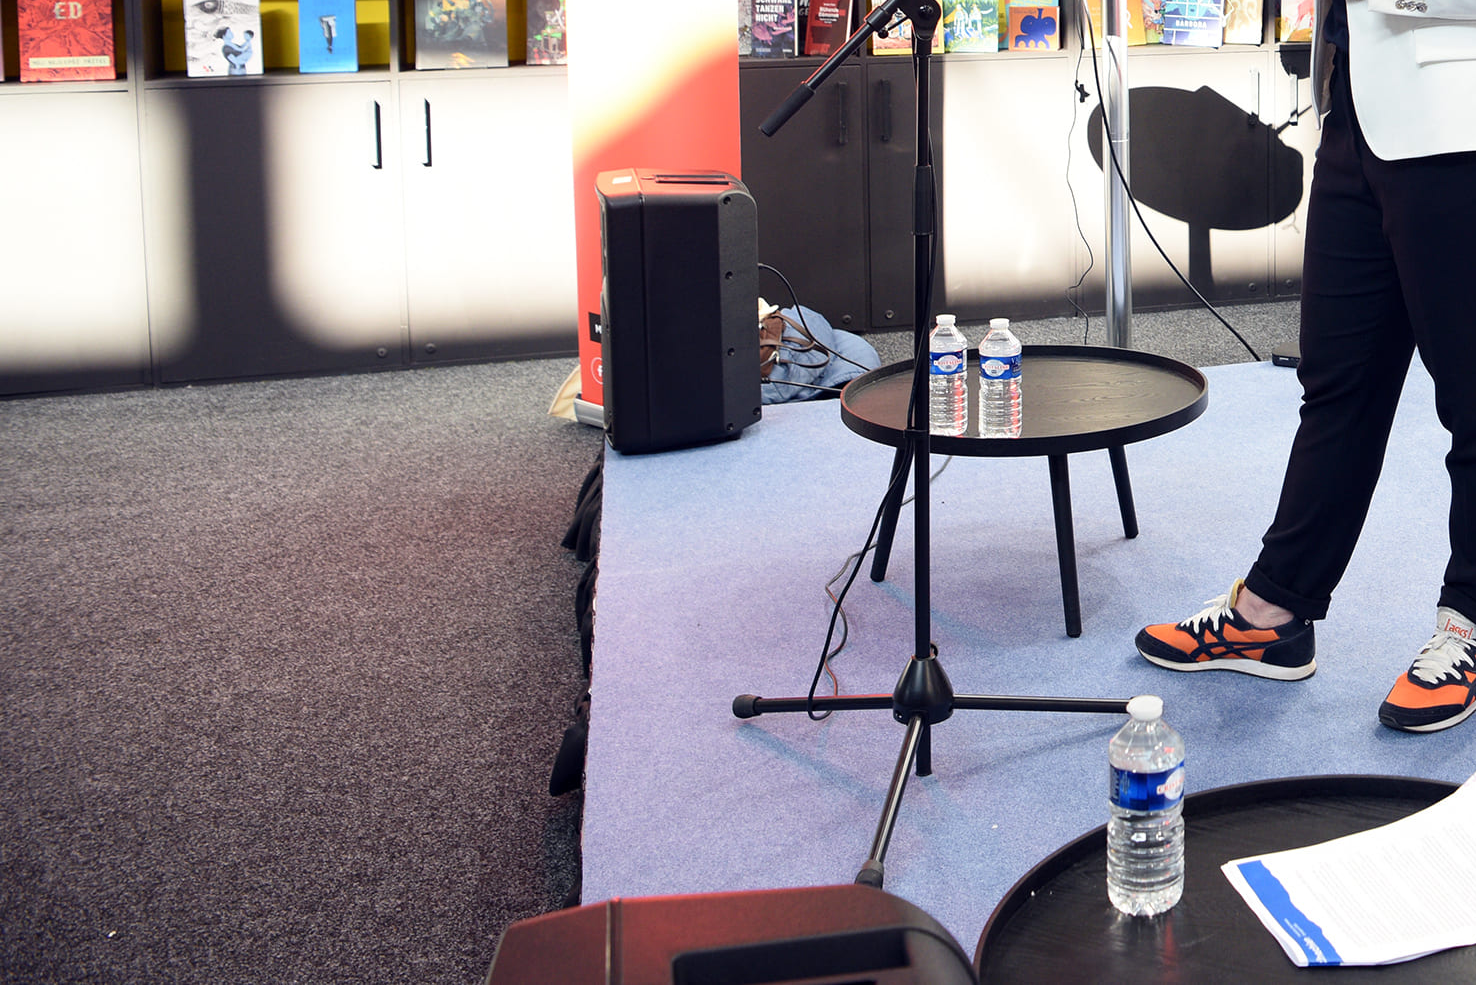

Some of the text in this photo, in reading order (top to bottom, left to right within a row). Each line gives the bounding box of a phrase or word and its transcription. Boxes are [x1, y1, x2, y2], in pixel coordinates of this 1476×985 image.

[54, 1, 82, 20] ED
[755, 5, 785, 13] TANZEN
[755, 14, 779, 23] NICHT
[1175, 19, 1207, 29] BARBORA
[1449, 624, 1468, 639] asics
